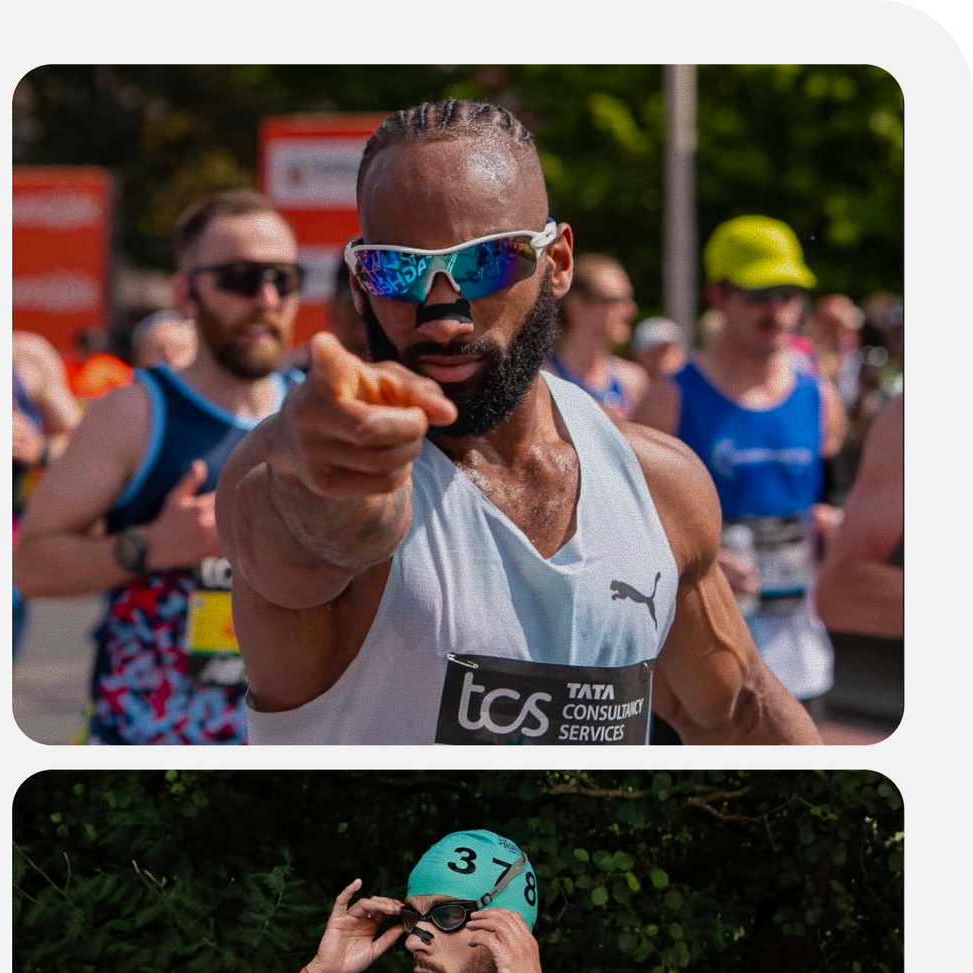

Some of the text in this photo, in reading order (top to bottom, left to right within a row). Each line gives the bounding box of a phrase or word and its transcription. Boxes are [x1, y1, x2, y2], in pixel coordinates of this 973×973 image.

[567, 682, 615, 700] TATA
[458, 671, 553, 737] tcs
[562, 697, 645, 721] CONSULTANCY
[558, 724, 625, 742] SERVICES
